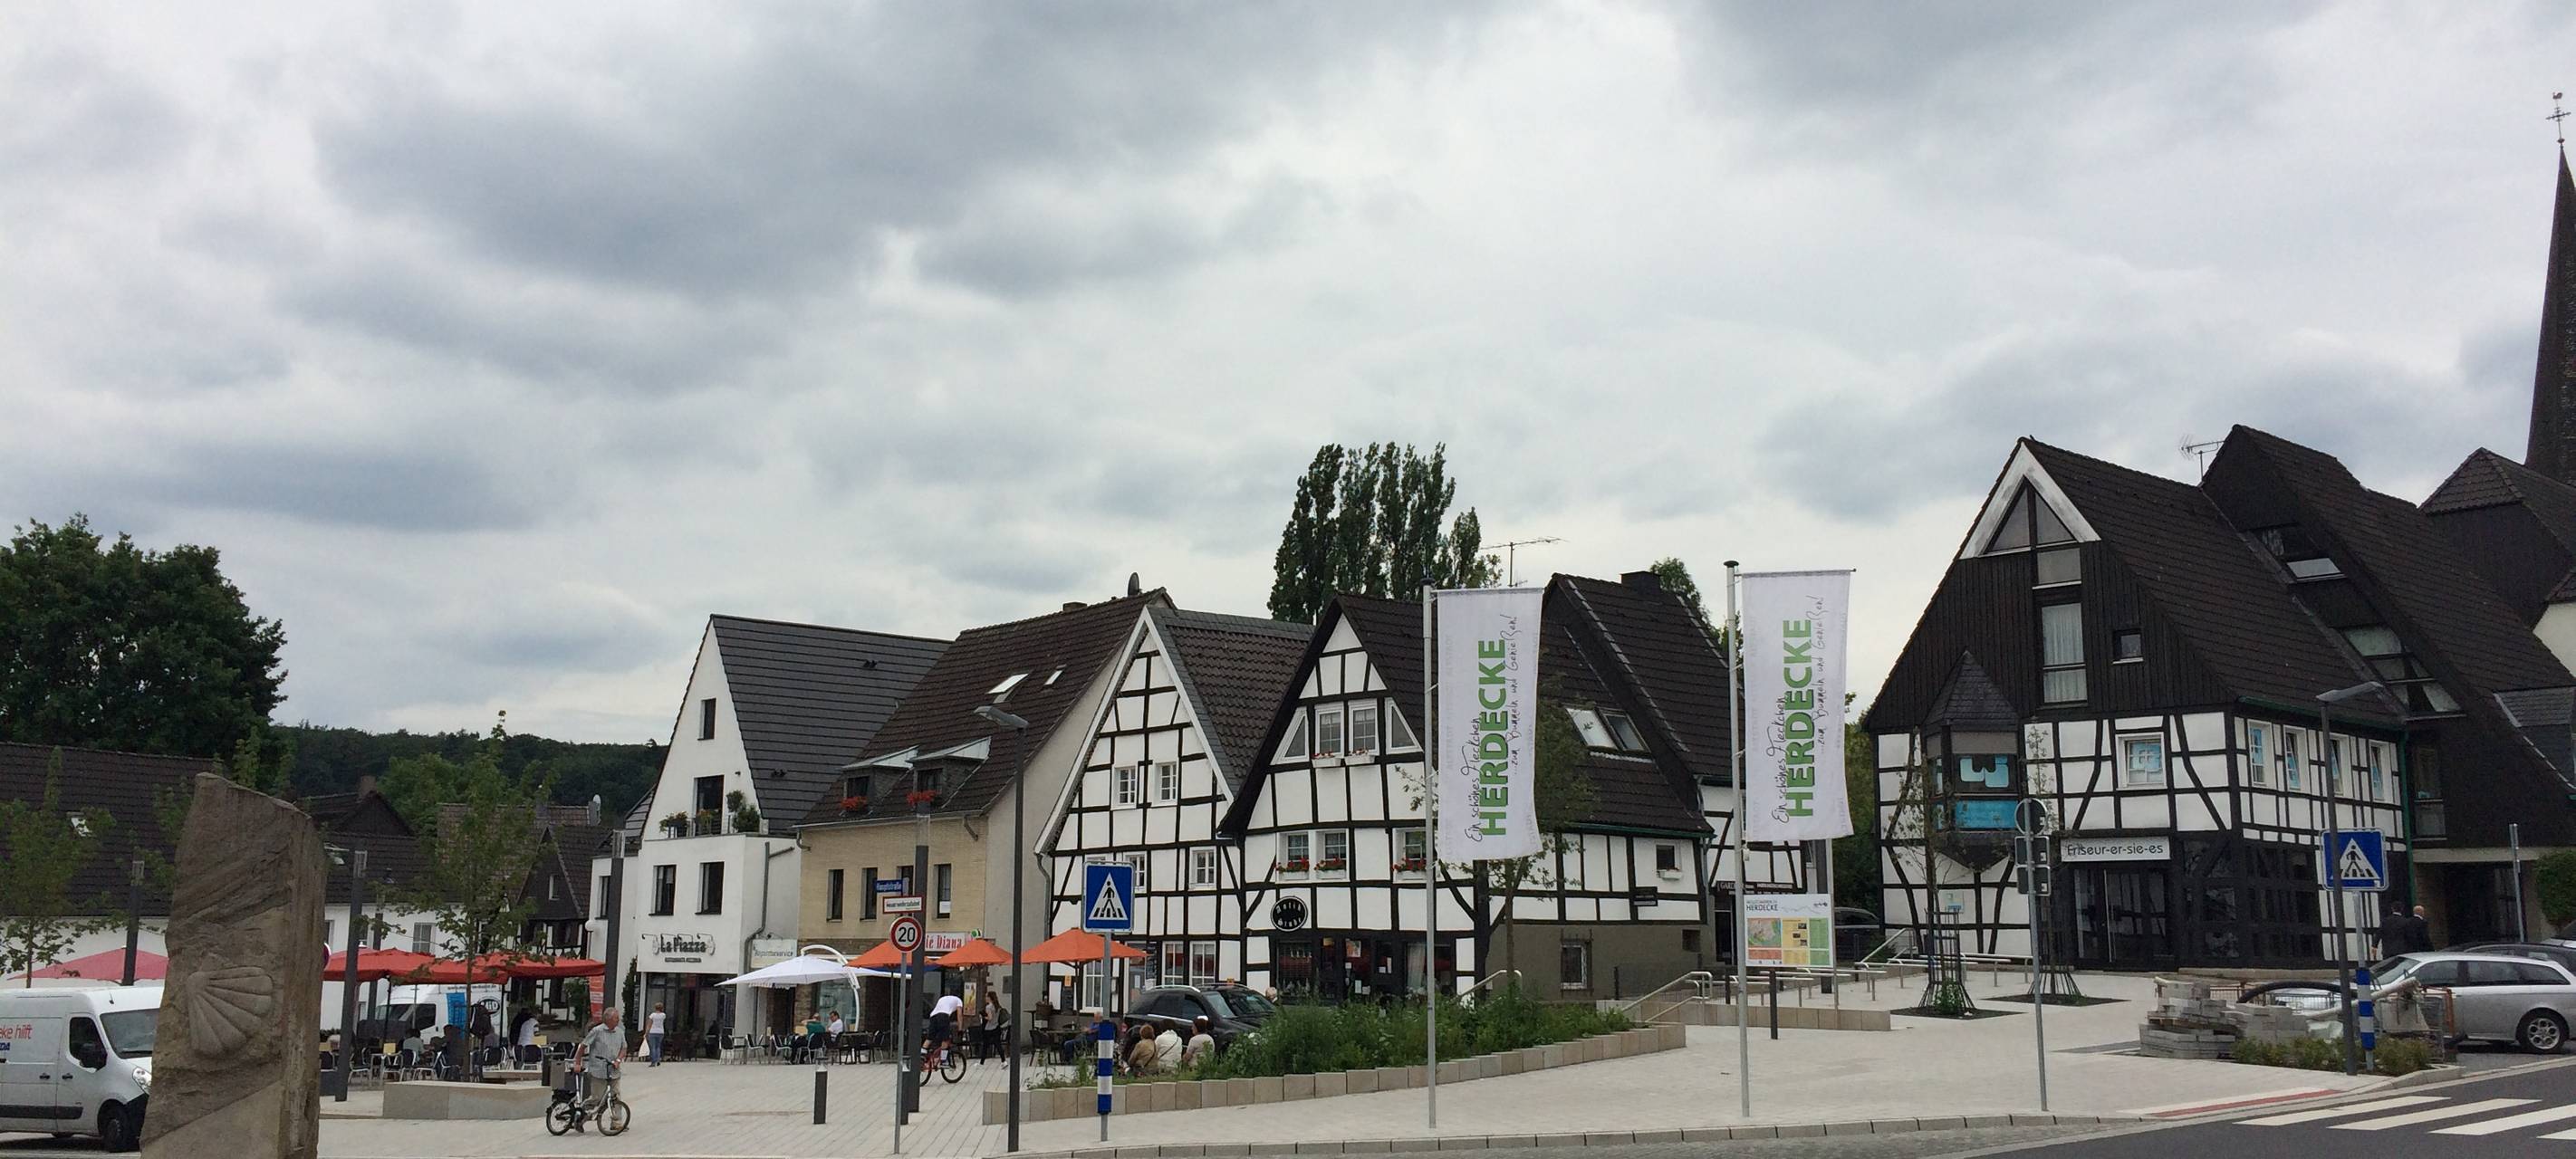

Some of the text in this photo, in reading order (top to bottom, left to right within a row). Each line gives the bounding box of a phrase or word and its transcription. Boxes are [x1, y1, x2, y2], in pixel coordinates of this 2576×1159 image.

[1766, 696, 1786, 758] Fleckchen
[1783, 619, 1815, 817] HERDECKE
[1478, 639, 1508, 835] HERDECKE
[1460, 716, 1483, 842] Ein schönes Fleckchen
[1772, 804, 1790, 823] Ein
[1745, 904, 1778, 912] HERDECKE
[898, 926, 916, 943] 20
[937, 934, 962, 949] Diana
[660, 936, 706, 953] La Piazza
[14, 1024, 33, 1039] hilft
